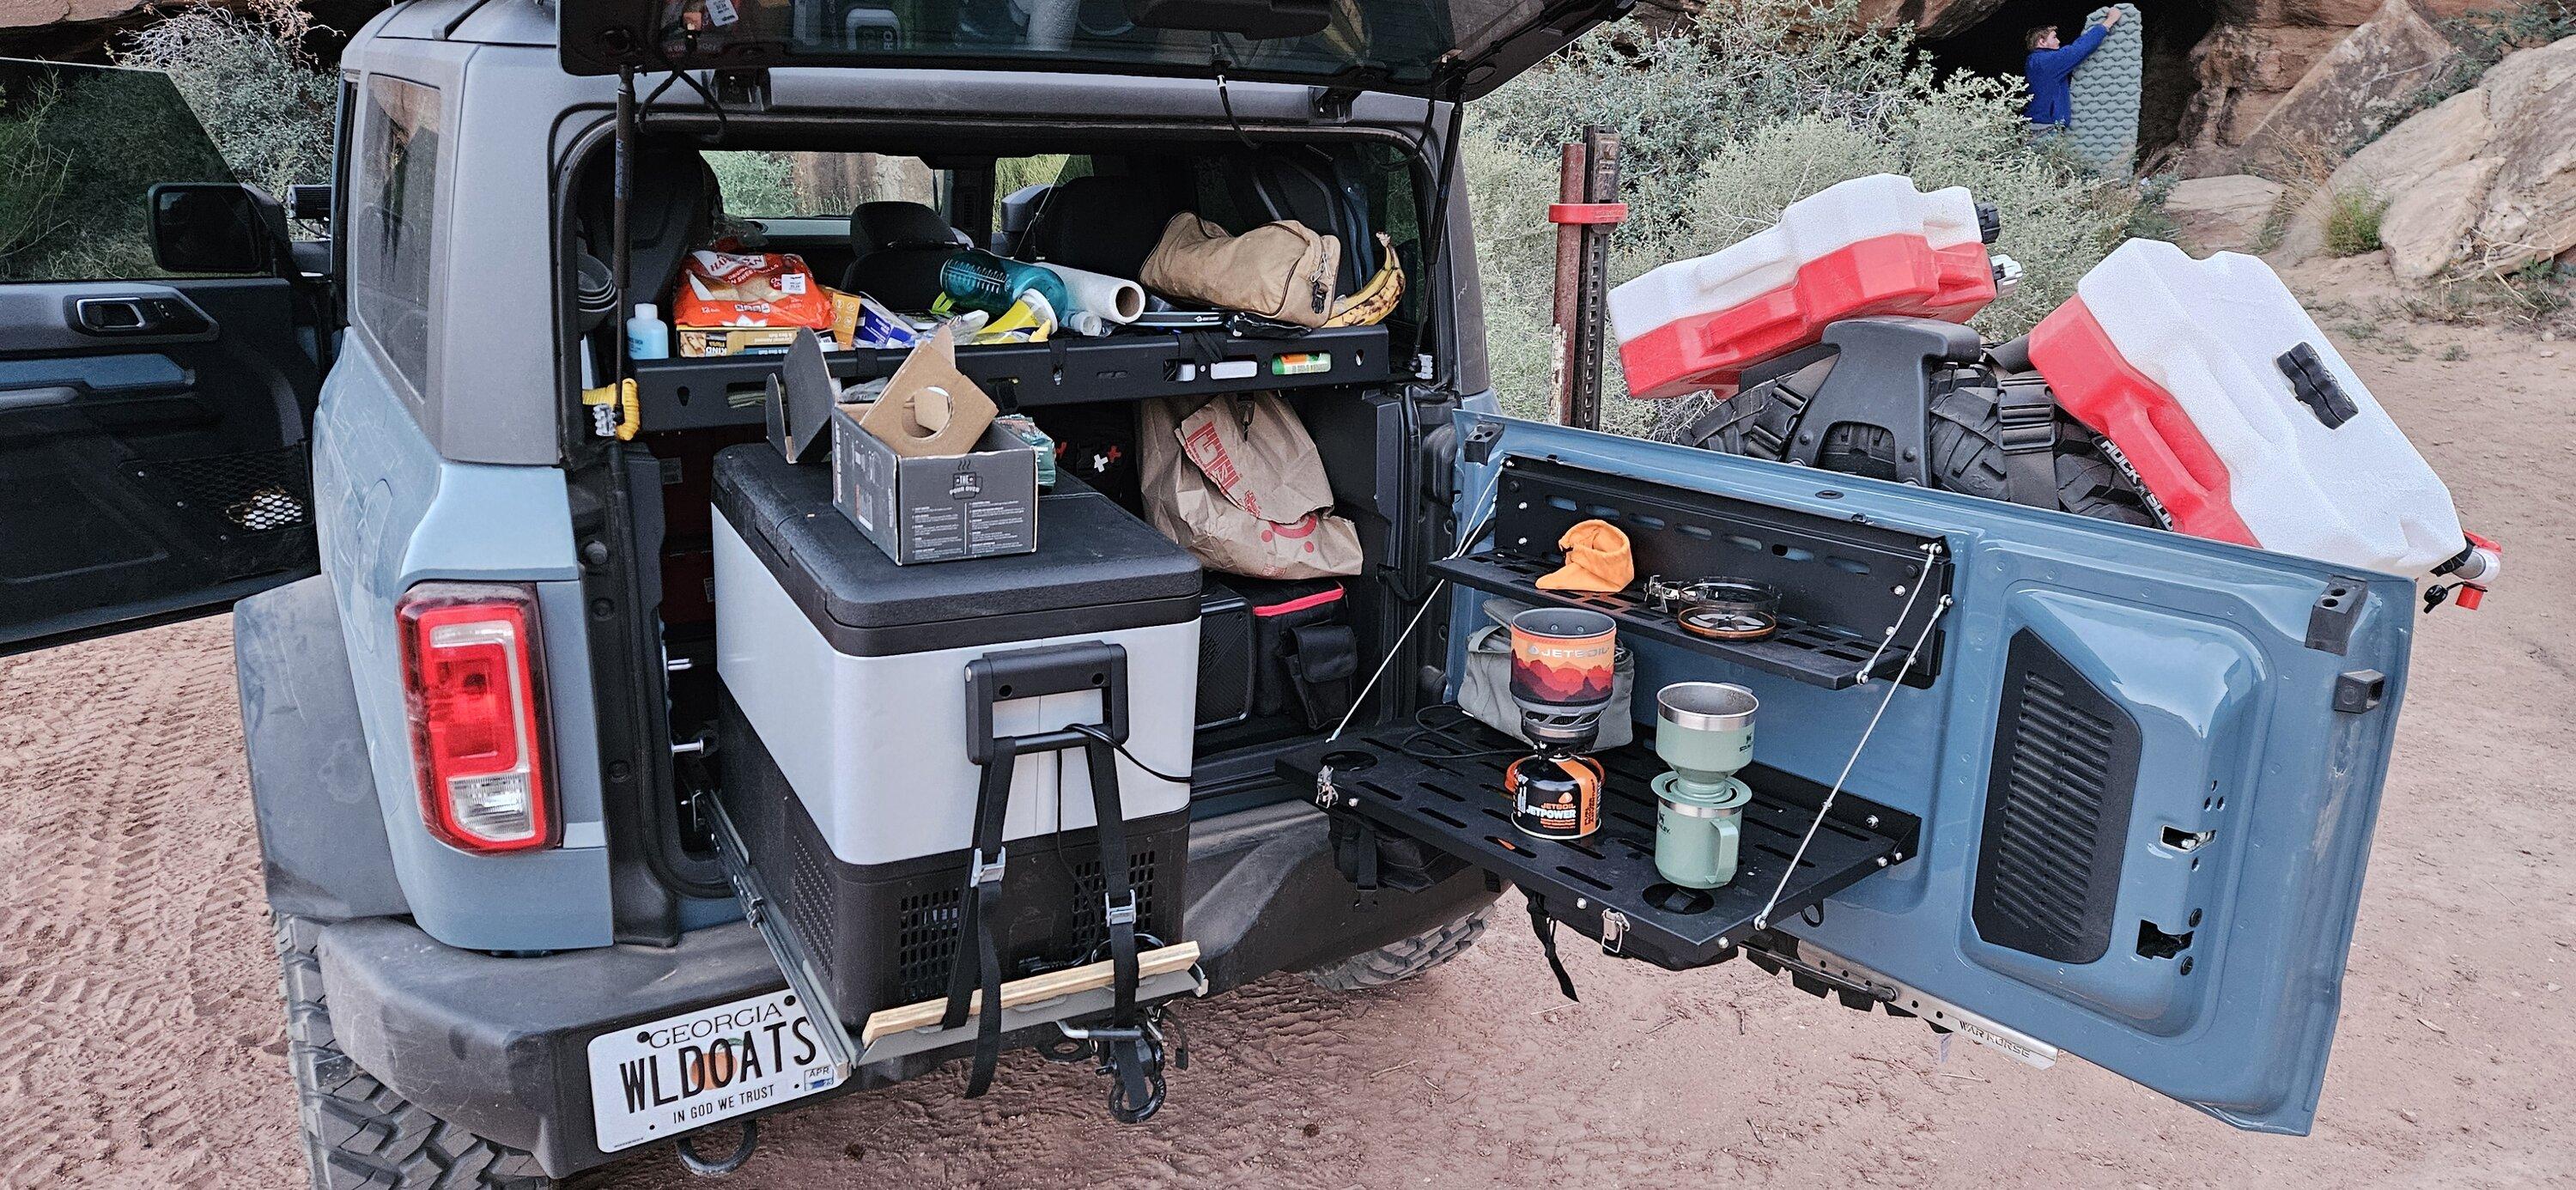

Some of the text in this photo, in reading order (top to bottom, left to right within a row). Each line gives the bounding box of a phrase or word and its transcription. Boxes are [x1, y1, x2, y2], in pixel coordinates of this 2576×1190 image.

[705, 346, 728, 356] KIND
[2100, 439, 2142, 485] ROCK
[1540, 647, 1610, 658] JETBOIL
[1526, 804, 1577, 819] JETPOWER
[648, 1002, 783, 1049] GEORGIA
[1959, 1020, 2031, 1059] WAR HORSE
[619, 1017, 817, 1114] WLDOATS
[809, 1067, 829, 1078] APR
[673, 1084, 775, 1124] IN GOD WE TRUST
